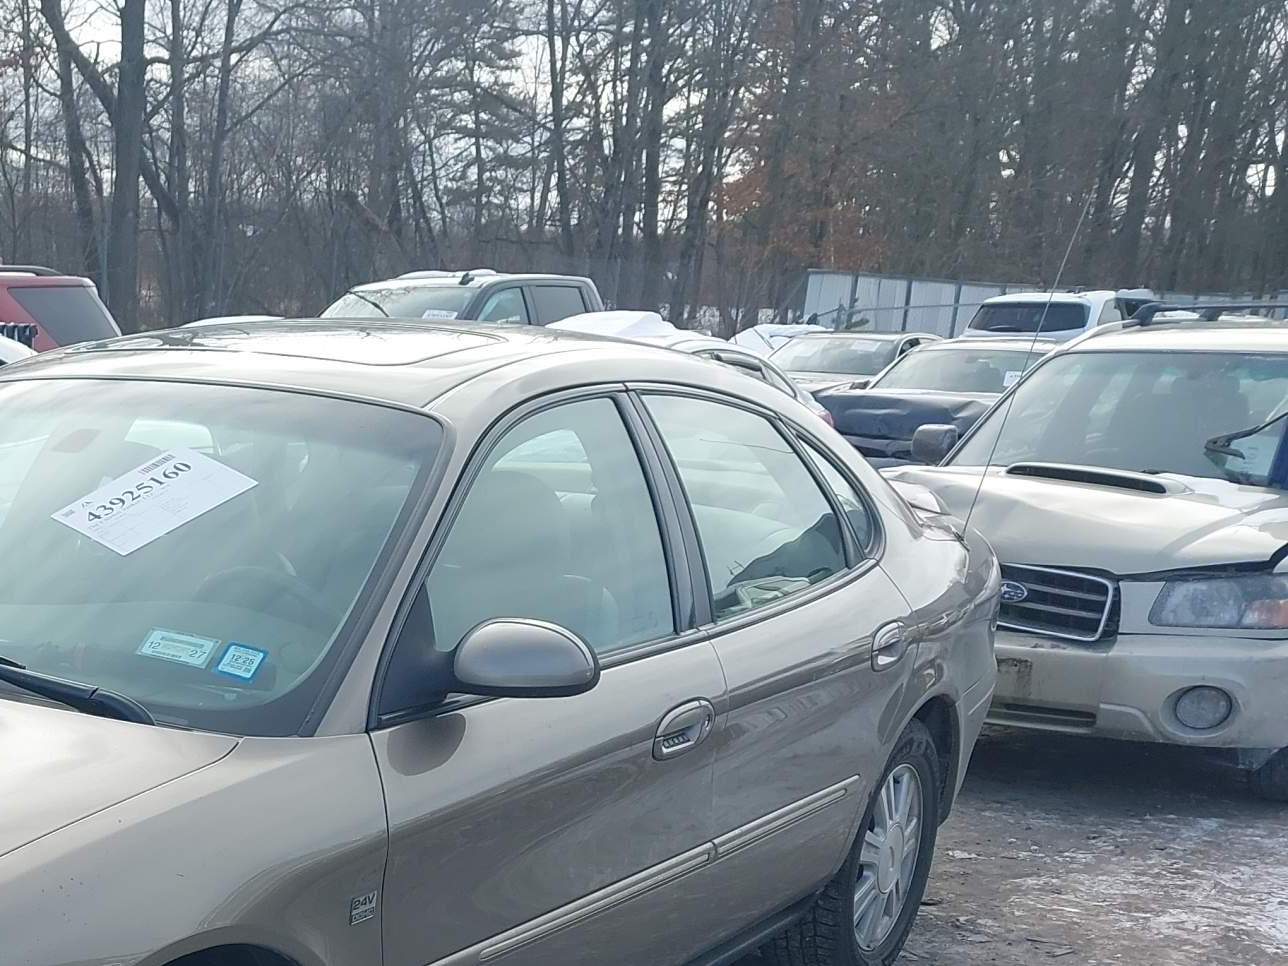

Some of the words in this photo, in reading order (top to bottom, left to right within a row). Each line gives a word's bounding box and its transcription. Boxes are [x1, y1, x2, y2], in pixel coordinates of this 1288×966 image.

[87, 461, 192, 523] 43925160
[148, 641, 161, 650] 12
[189, 649, 207, 659] 27
[353, 893, 376, 910] 24V
